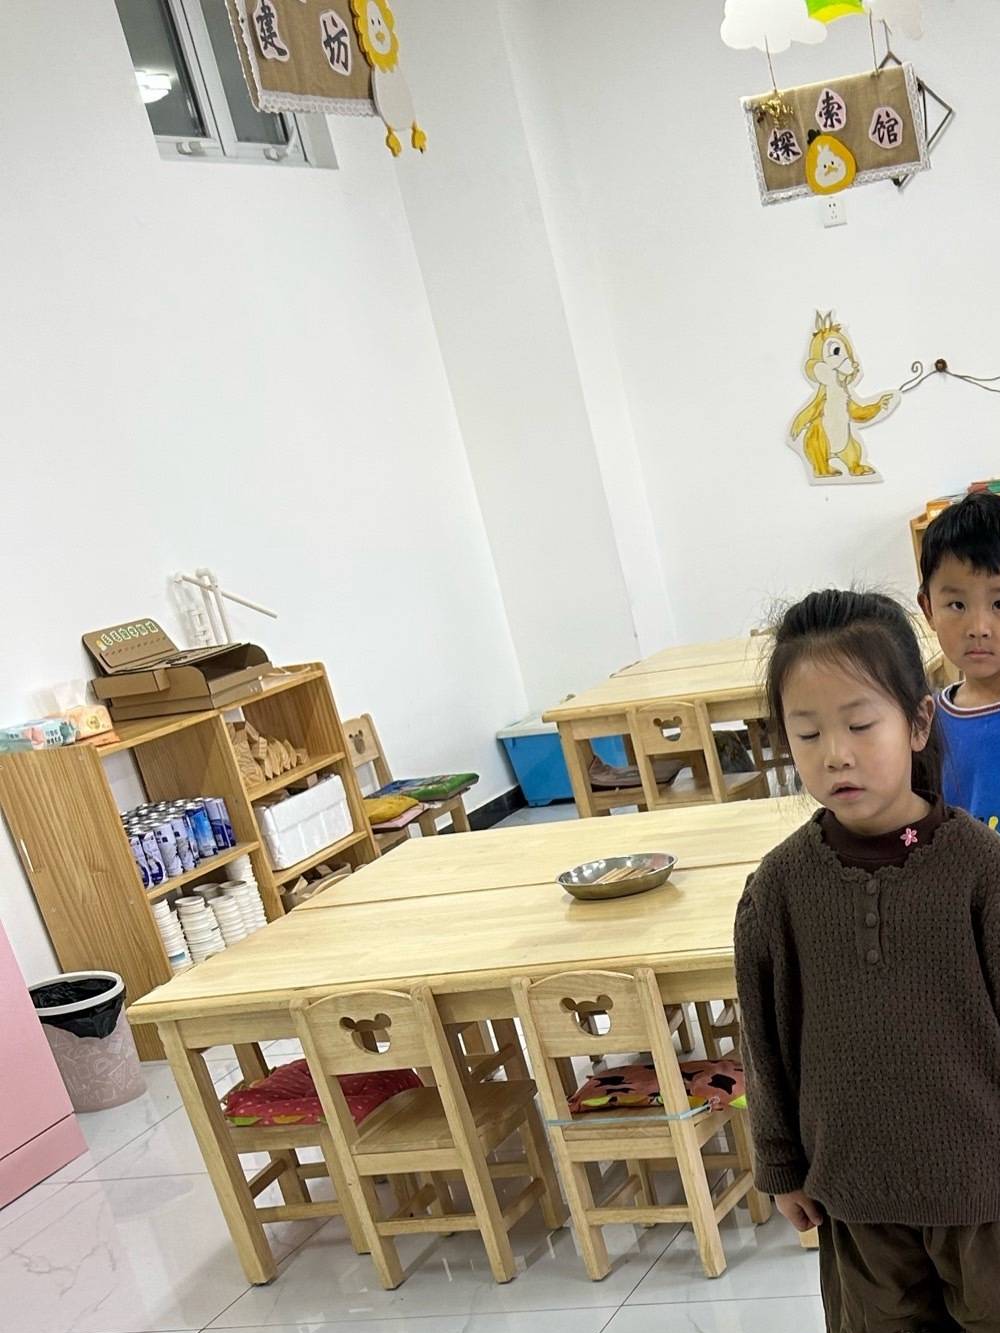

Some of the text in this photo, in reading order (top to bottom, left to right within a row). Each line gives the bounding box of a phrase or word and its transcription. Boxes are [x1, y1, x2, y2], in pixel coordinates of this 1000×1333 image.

[256, 0, 349, 72] 建坊
[768, 90, 899, 162] 探索馆
